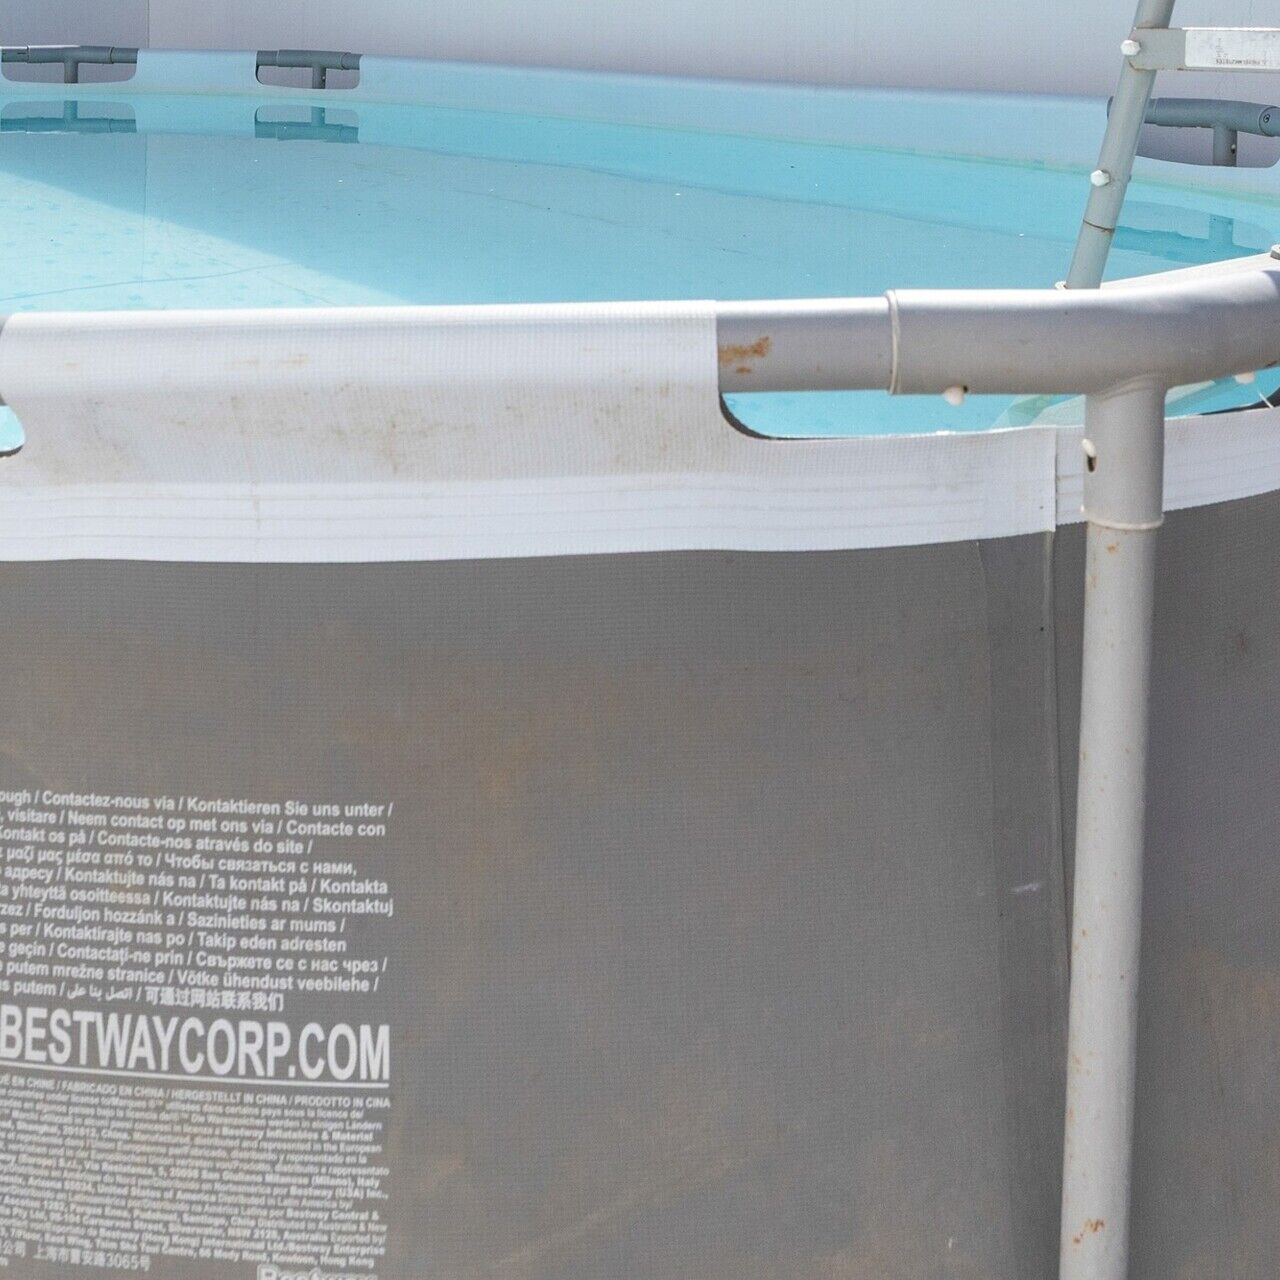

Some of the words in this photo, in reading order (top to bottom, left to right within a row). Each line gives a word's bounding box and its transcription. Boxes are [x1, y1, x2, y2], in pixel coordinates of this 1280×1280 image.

[41, 789, 150, 809] Contactez-nous
[152, 795, 175, 810] via
[186, 796, 281, 815] Kontaktieren
[284, 800, 308, 815] Sie
[312, 804, 340, 816] uns
[344, 802, 385, 817] unter
[6, 808, 57, 824] visitare
[67, 810, 107, 826] Neem
[110, 814, 164, 828] contact
[166, 818, 186, 833] op
[188, 817, 217, 831] met
[219, 820, 248, 833] ons
[251, 819, 274, 834] via
[285, 819, 354, 836] Contacte
[356, 824, 386, 836] con
[48, 831, 65, 843] os
[68, 829, 86, 846] på
[96, 830, 192, 849] Contacte-nos
[195, 836, 250, 852] através
[252, 838, 273, 853] do
[276, 839, 304, 854] site
[6, 845, 34, 863] μαζί
[36, 850, 63, 865] μας
[65, 851, 101, 865] μέσα
[136, 854, 153, 867] το
[164, 853, 214, 869] Чтобы
[217, 858, 296, 873] связаться
[312, 862, 357, 875] нами,
[4, 866, 54, 884] адресу
[64, 866, 145, 888] Kontaktujte
[148, 871, 174, 887] nás
[177, 875, 196, 888] na
[207, 873, 226, 889] Ta
[229, 875, 285, 892] kontakt
[288, 877, 308, 895] på
[319, 878, 388, 894] Kontakta
[162, 891, 247, 913] Kontaktujte
[250, 895, 278, 911] nás
[280, 899, 300, 912] na
[312, 897, 394, 917] Skontaktuj
[165, 913, 176, 925] a
[270, 918, 286, 930] ar
[289, 919, 337, 932] mums
[9, 923, 32, 938] per
[43, 922, 132, 945] Kontaktirajte
[136, 931, 162, 944] nas
[165, 933, 185, 948] po
[196, 931, 236, 951] Takip
[239, 935, 277, 950] eden
[280, 937, 347, 952] adresten
[6, 960, 49, 976] putem
[106, 967, 165, 983] stranice
[296, 976, 370, 992] veebilehe
[154, 949, 184, 967] prin
[310, 959, 338, 972] нас
[342, 959, 379, 975] чрез
[12, 980, 57, 996] putem
